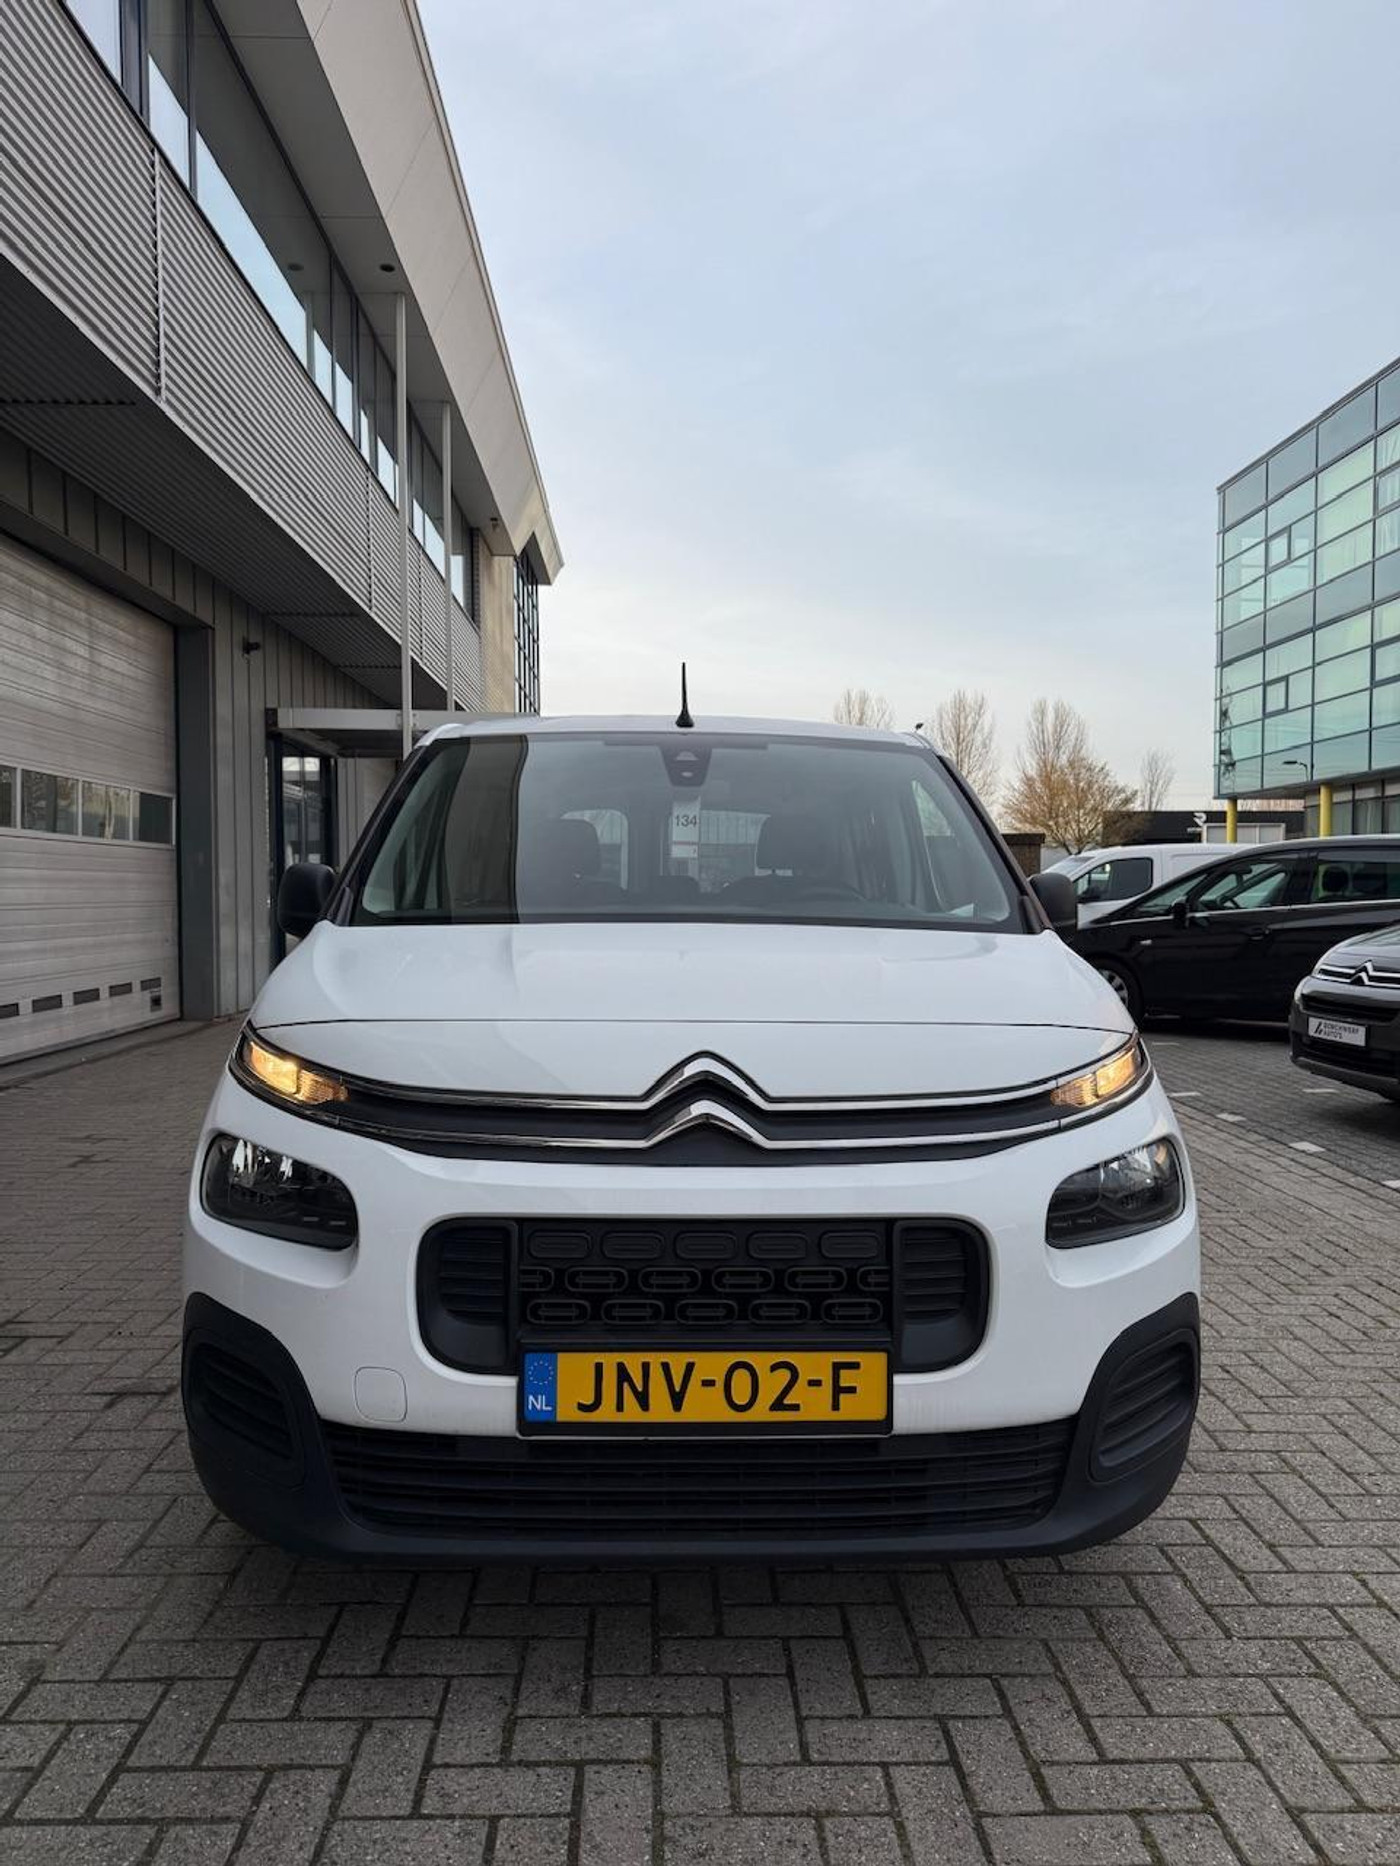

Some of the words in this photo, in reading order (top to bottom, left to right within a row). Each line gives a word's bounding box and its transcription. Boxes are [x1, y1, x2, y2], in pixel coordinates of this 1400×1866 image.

[676, 814, 698, 828] 134
[576, 1360, 861, 1413] JNV-02-F
[528, 1394, 552, 1411] NL
